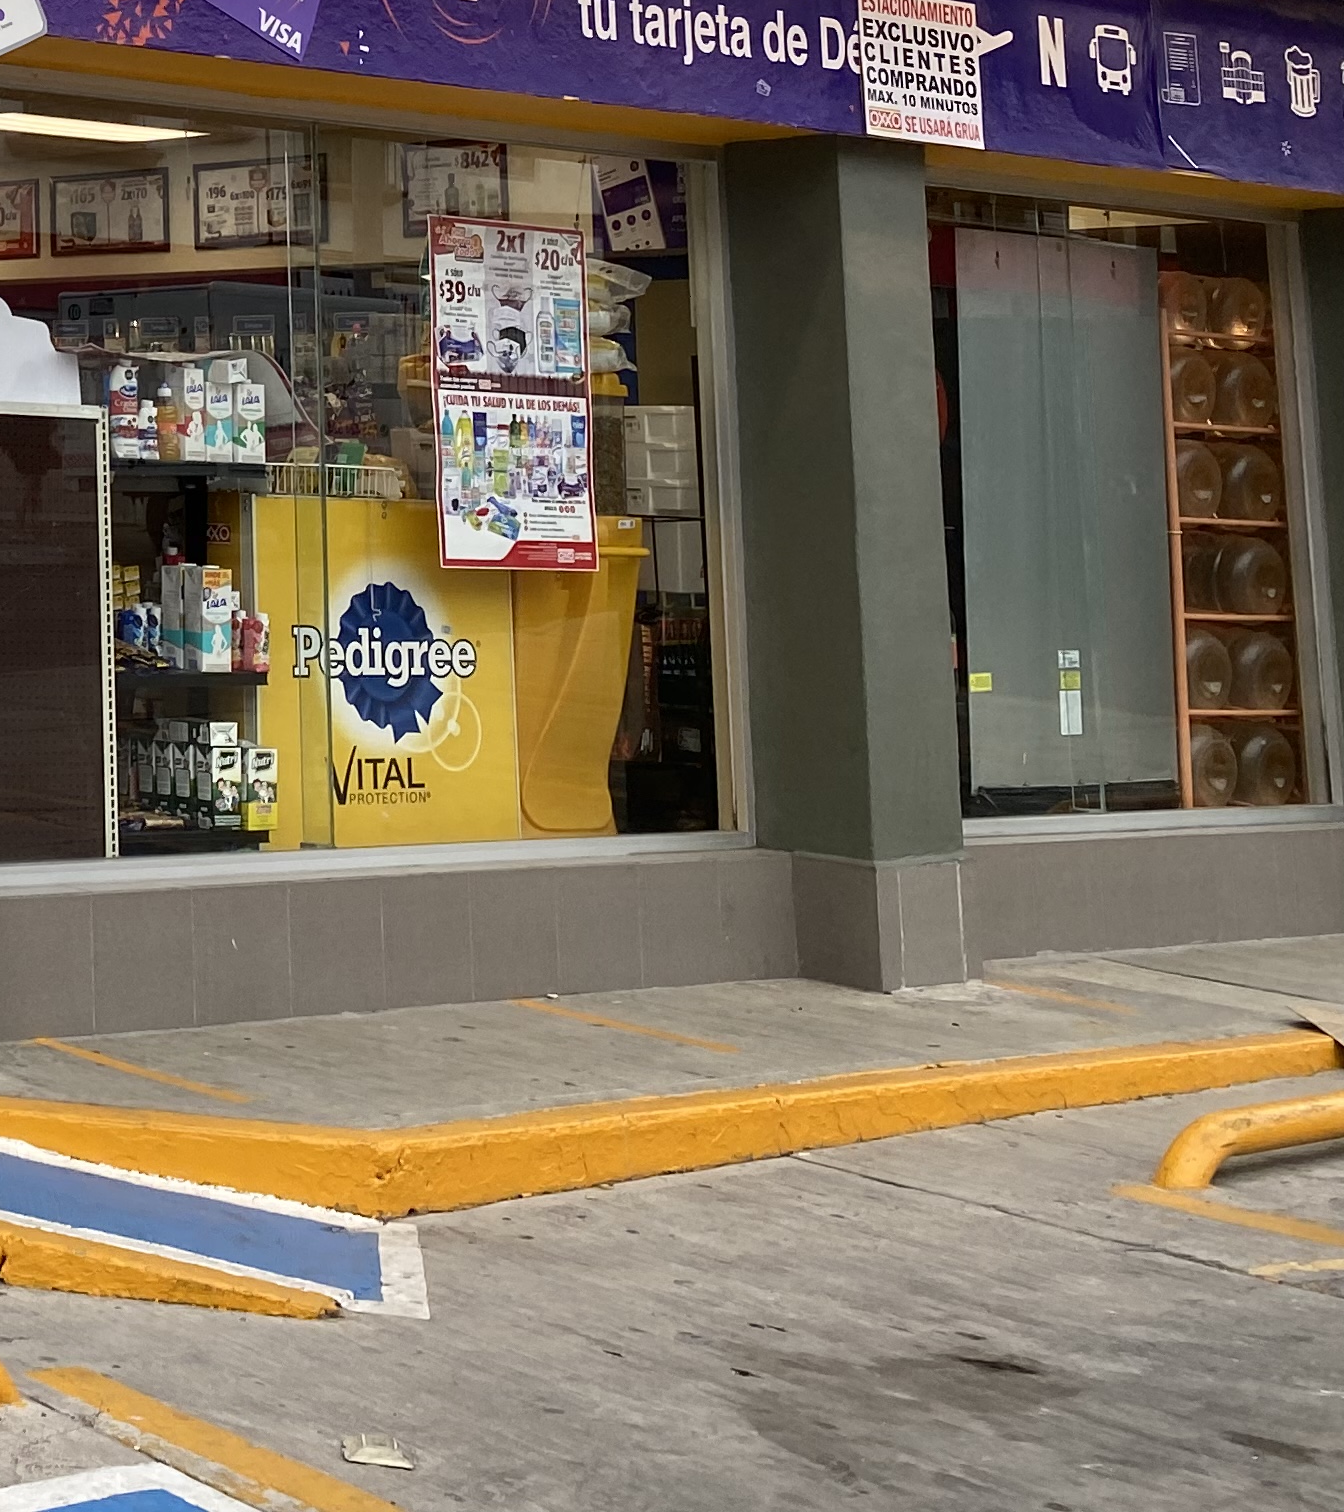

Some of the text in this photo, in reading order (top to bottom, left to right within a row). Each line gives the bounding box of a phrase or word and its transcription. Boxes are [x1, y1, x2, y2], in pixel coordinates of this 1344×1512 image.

[258, 6, 303, 54] VISA
[762, 10, 810, 67] de
[862, 17, 974, 53] EXCLUSIVO
[864, 41, 976, 77] CLIENTES
[866, 66, 977, 99] COMPRANDO
[867, 88, 979, 116] MAX. 10 MINUTOS
[869, 110, 902, 130] OXXO
[904, 115, 982, 142] SE USARÁ GRÚA
[496, 229, 526, 254] 2x1
[534, 248, 561, 271] $20
[439, 279, 466, 304] $39
[471, 395, 481, 406] TU
[483, 396, 507, 408] SALUD
[508, 397, 514, 408] Y
[515, 398, 525, 410] LA
[526, 398, 536, 410] DE
[537, 399, 552, 411] LOS
[292, 625, 477, 687] Pedigree
[330, 745, 426, 805] VITAL
